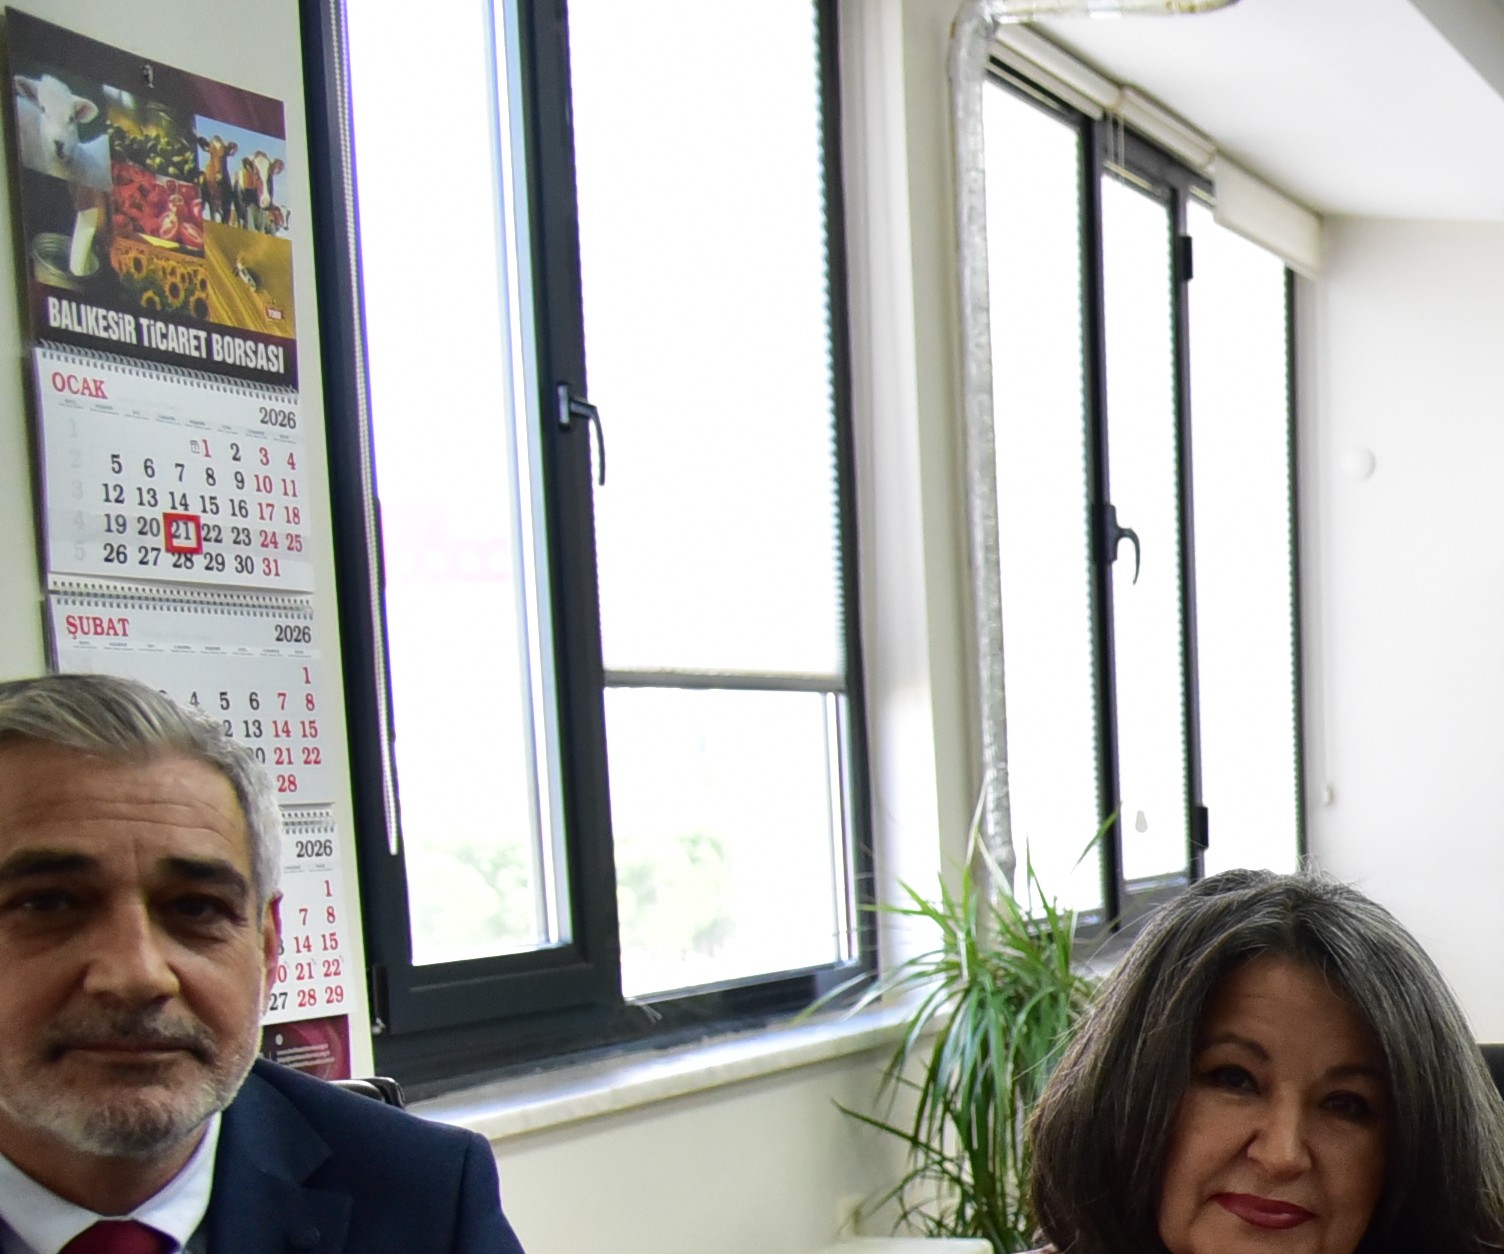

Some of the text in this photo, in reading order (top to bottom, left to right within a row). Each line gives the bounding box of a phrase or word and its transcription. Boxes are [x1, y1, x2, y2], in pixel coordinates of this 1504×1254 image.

[211, 333, 284, 373] BORSASI
[52, 372, 108, 399] OCAK
[259, 407, 296, 429] 2026
[202, 439, 212, 457] 1
[230, 443, 241, 461] 2
[259, 448, 270, 465] 3
[287, 453, 296, 470] 4
[111, 454, 122, 474] 5
[144, 458, 155, 477] 6
[175, 463, 185, 482] 7
[206, 467, 216, 486] 8
[234, 471, 245, 490] 9
[254, 474, 273, 494] 10
[282, 479, 297, 498] 11
[103, 483, 125, 504] 12
[137, 487, 158, 507] 13
[169, 492, 189, 511] 14
[200, 495, 219, 515] 15
[229, 499, 248, 518] 16
[258, 502, 275, 521] 17
[285, 506, 300, 524] 18
[104, 514, 127, 534] 19
[137, 517, 160, 537] 20
[172, 521, 192, 540] 21
[202, 524, 223, 543] 22
[232, 527, 251, 546] 23
[259, 531, 278, 548] 24
[286, 534, 302, 551] 25
[103, 543, 127, 563] 26
[138, 546, 161, 566] 27
[172, 552, 194, 569] 28
[204, 553, 225, 571] 29
[235, 556, 254, 574] 30
[262, 558, 280, 576] 31
[66, 615, 130, 640] ŞUBAT
[275, 625, 311, 643] 2026
[303, 667, 311, 684] 1
[190, 691, 315, 711] 4 5 6 7 8
[243, 720, 263, 738] 13
[272, 720, 291, 738] 14
[300, 720, 318, 738] 15
[275, 748, 294, 765] 21
[302, 748, 321, 764] 22
[277, 774, 297, 792] 28
[296, 839, 333, 858] 2026
[324, 880, 333, 897] 1
[299, 906, 335, 926] 7 8
[294, 936, 312, 953] 14
[321, 933, 338, 951] 15
[296, 962, 314, 980] 21
[322, 959, 341, 977] 22
[270, 985, 344, 1011] 27 28 29
